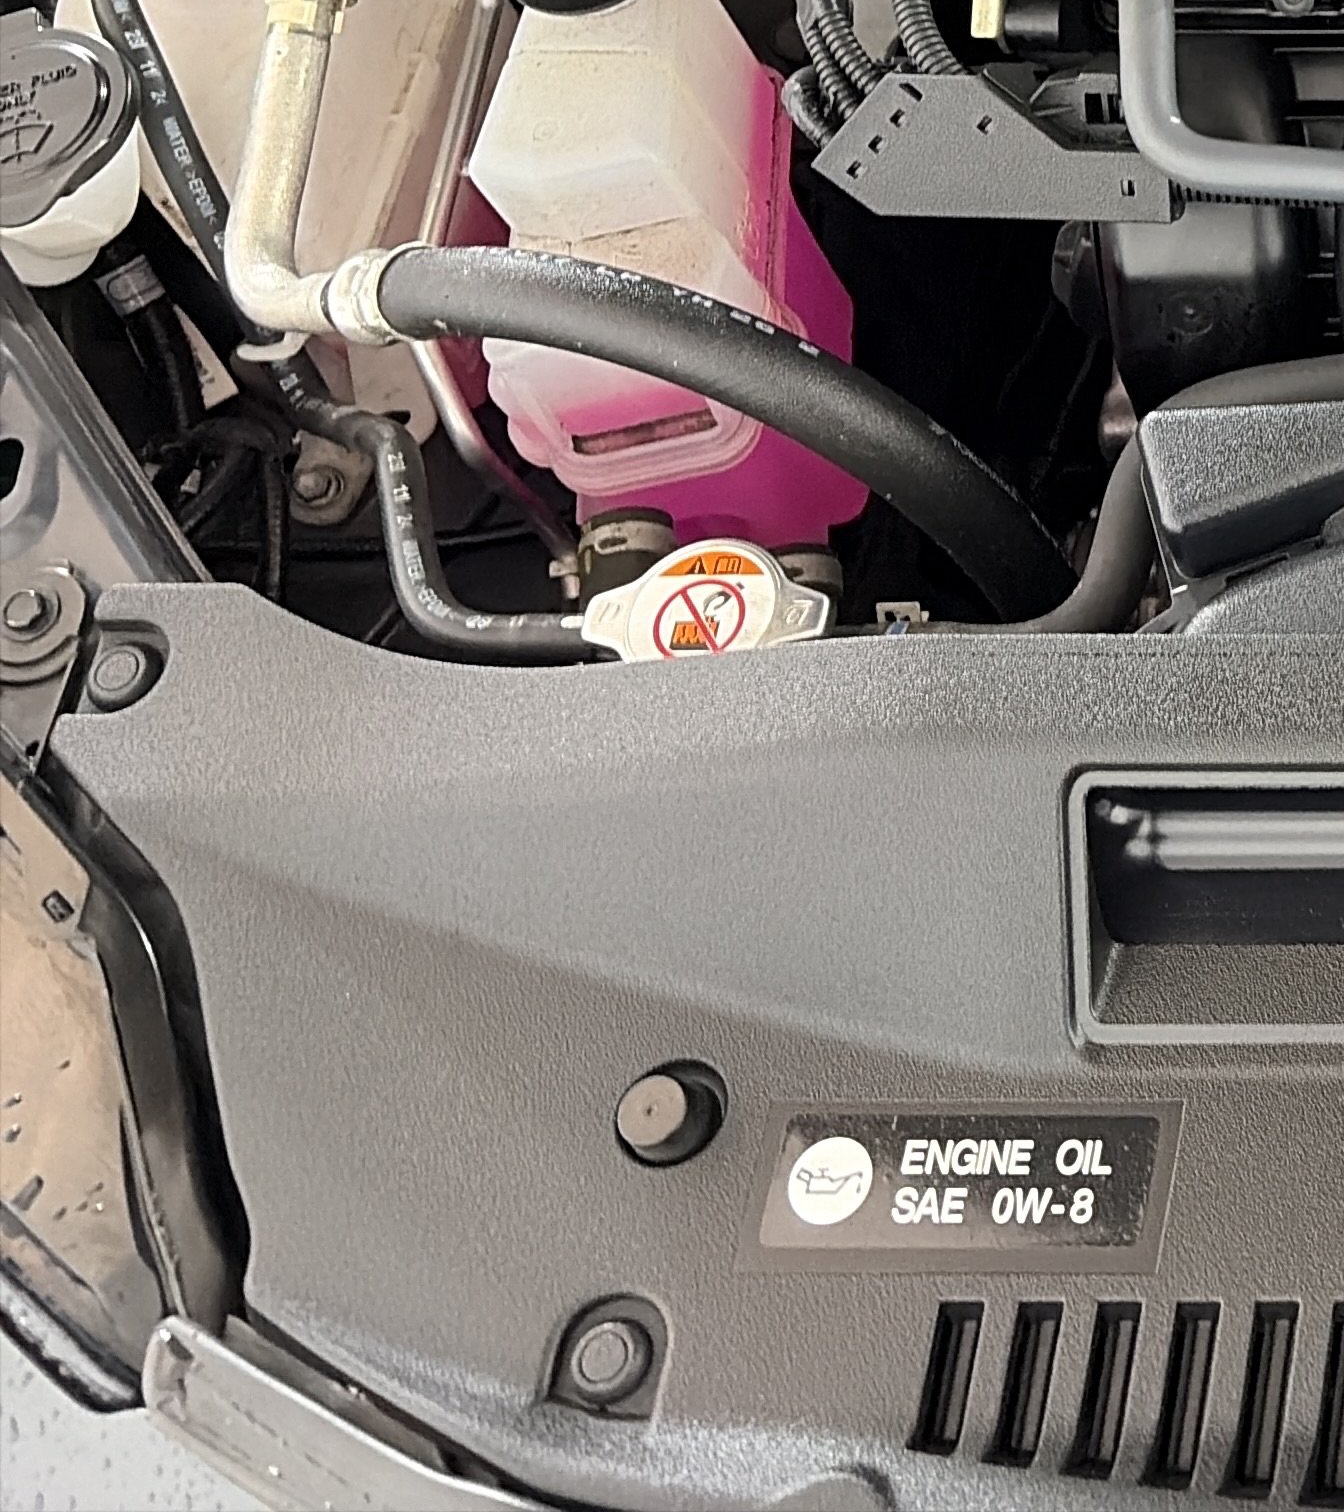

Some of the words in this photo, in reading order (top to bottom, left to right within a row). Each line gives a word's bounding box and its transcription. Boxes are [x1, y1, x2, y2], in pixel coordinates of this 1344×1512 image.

[163, 115, 193, 172] WATER
[900, 1139, 1035, 1176] ENGINE
[1055, 1139, 1112, 1176] OIL
[891, 1187, 969, 1225] SAE
[991, 1187, 1095, 1225] 0W-8
